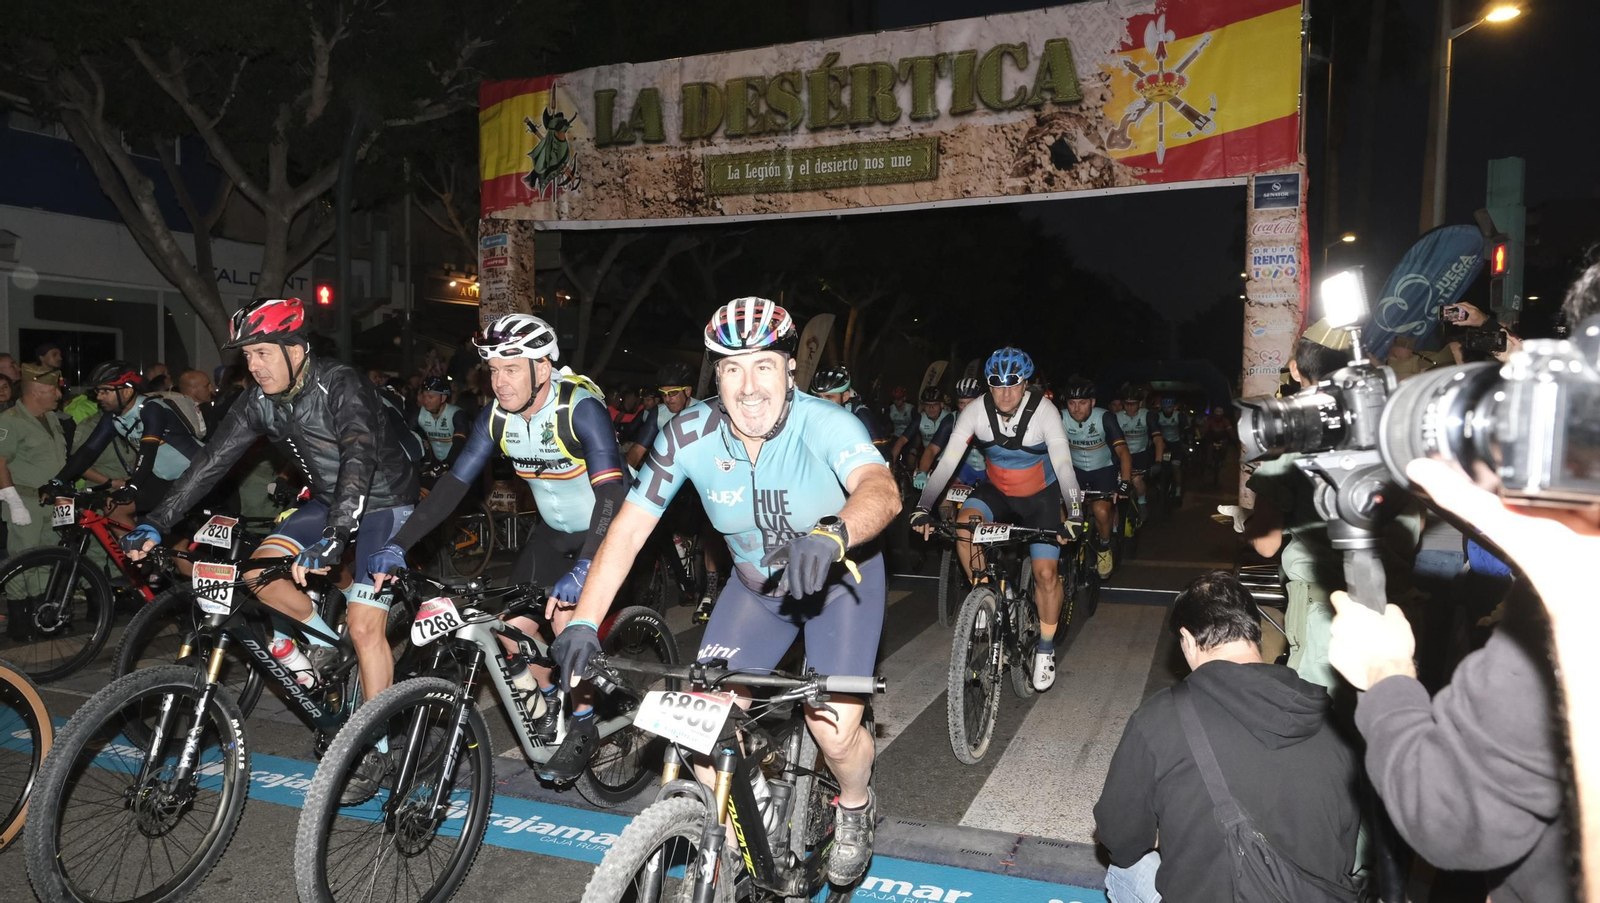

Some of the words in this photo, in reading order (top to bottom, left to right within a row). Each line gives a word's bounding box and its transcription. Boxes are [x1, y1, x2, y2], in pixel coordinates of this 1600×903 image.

[594, 88, 666, 146] LA
[680, 38, 1084, 141] DESÉRTICA
[727, 163, 740, 179] La
[745, 161, 781, 180] Legión
[787, 163, 794, 179] y
[800, 159, 811, 174] el
[815, 157, 858, 174] desierto
[864, 157, 884, 170] nos
[891, 153, 912, 167] une
[1253, 254, 1296, 265] RENTA
[1254, 246, 1295, 254] GRUPO
[1436, 254, 1473, 295] JUEGA
[706, 486, 746, 507] HUEX
[754, 489, 792, 515] HUE
[202, 524, 229, 540] 7820
[980, 525, 1008, 536] 6479
[415, 612, 458, 639] 7268
[633, 615, 660, 627] MAXXIS
[242, 639, 322, 719] MONDRAKER
[423, 692, 455, 703] MAXX
[495, 654, 544, 748] LAPIERRE
[230, 718, 246, 770] MAXXIS
[488, 814, 620, 846] cajama
[580, 842, 612, 852] RUR
